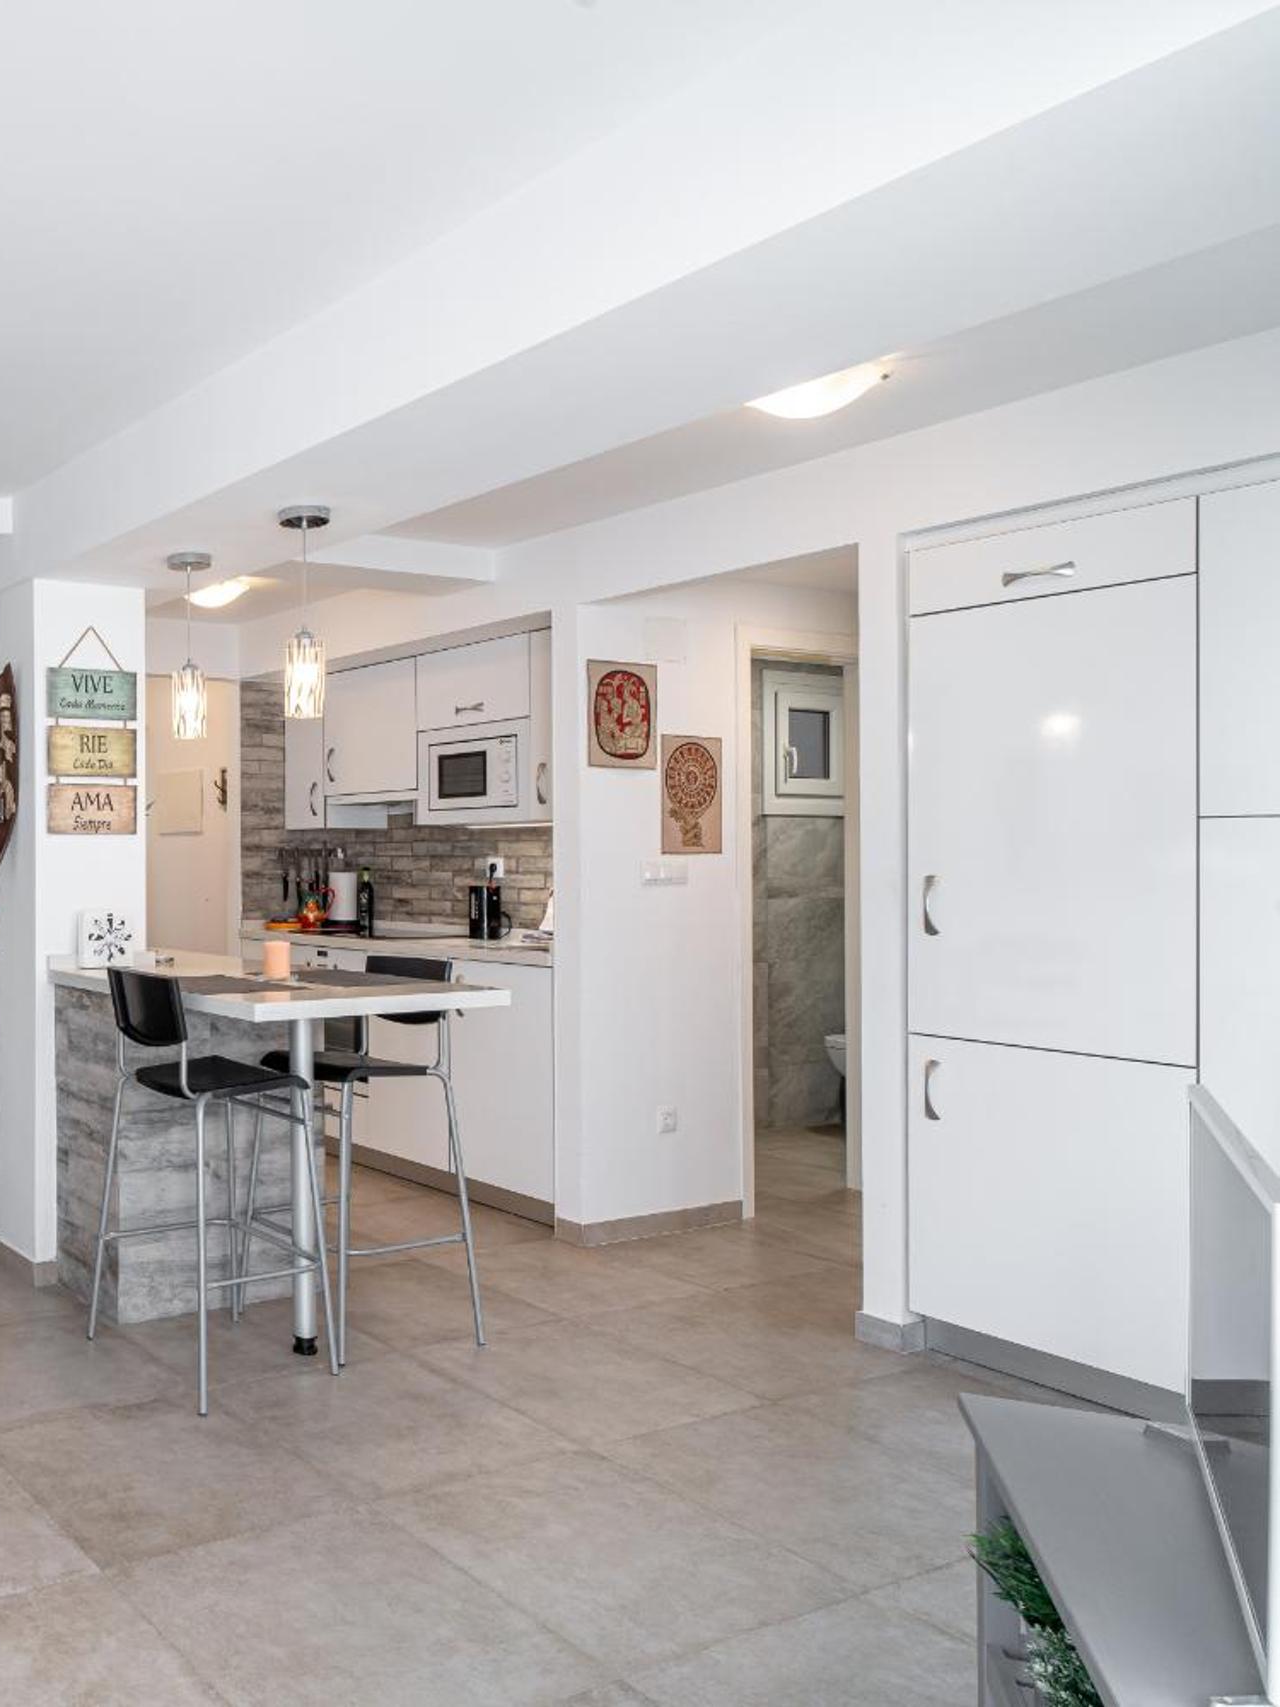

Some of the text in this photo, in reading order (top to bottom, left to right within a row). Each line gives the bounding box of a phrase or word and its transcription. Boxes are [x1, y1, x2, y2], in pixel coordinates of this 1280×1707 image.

[71, 673, 114, 694] VIVE
[79, 734, 108, 754] RIE
[71, 791, 114, 812] AMA
[72, 815, 112, 834] Siempre
